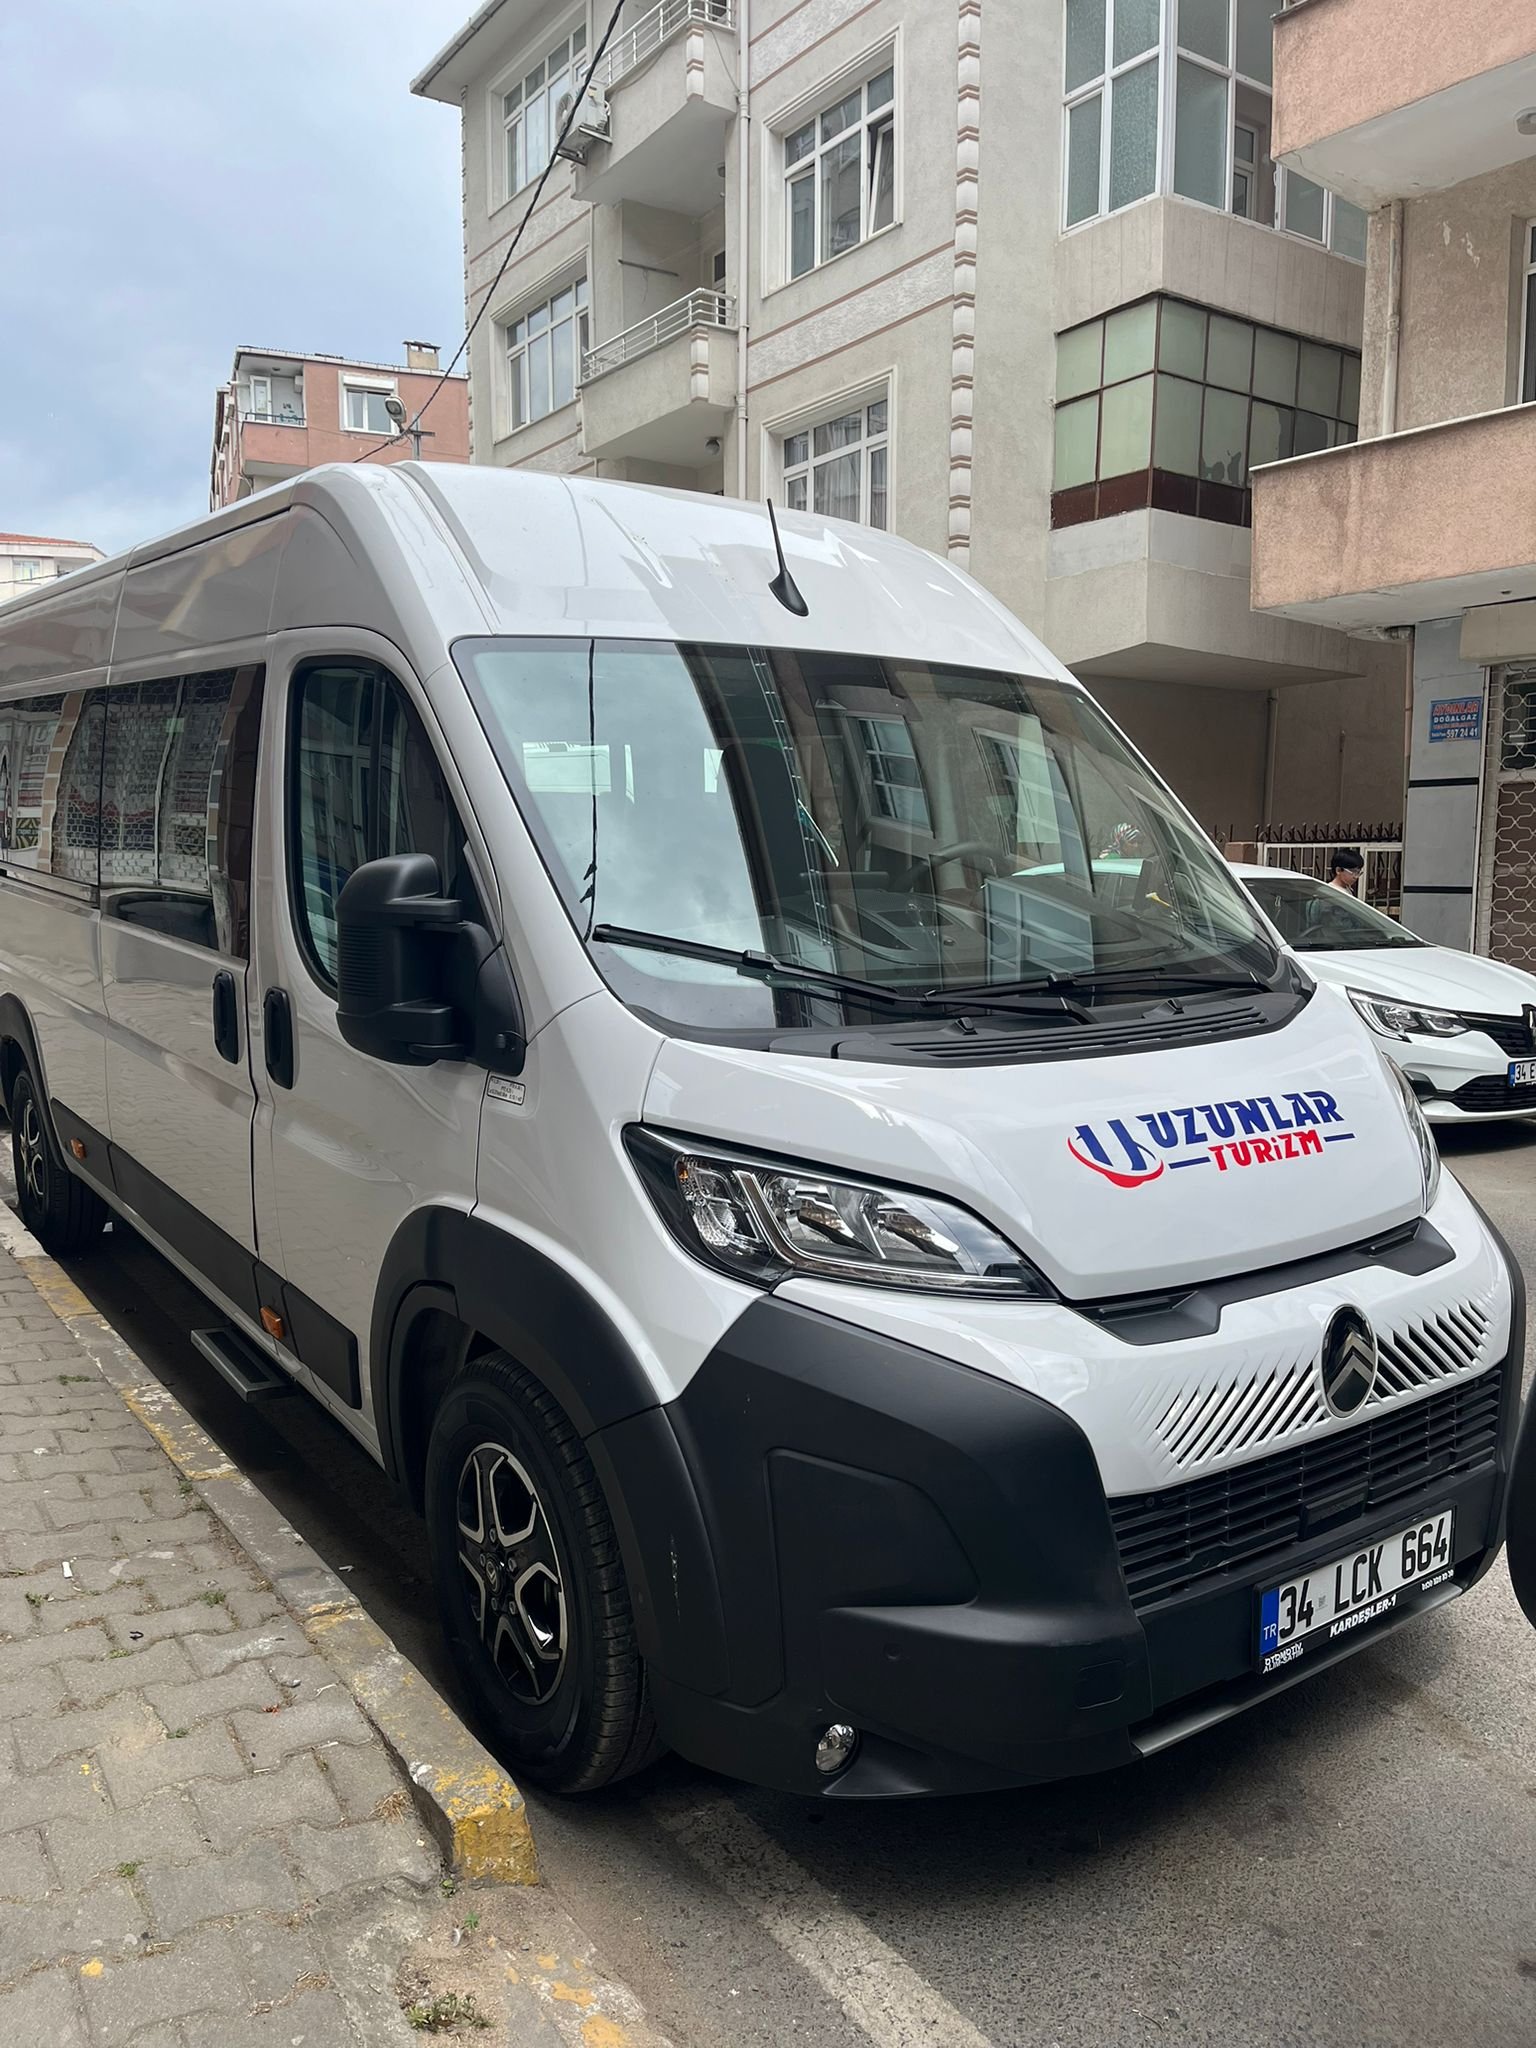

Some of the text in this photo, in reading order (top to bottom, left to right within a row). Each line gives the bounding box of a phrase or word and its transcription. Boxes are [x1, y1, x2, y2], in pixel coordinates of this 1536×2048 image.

[1515, 1064, 1526, 1081] 34
[1136, 1091, 1344, 1148] UZUNLAR
[1278, 1517, 1448, 1639] 34 LCK 664
[1263, 1623, 1277, 1641] TR
[1329, 1594, 1397, 1638] KARDEŞLER-1
